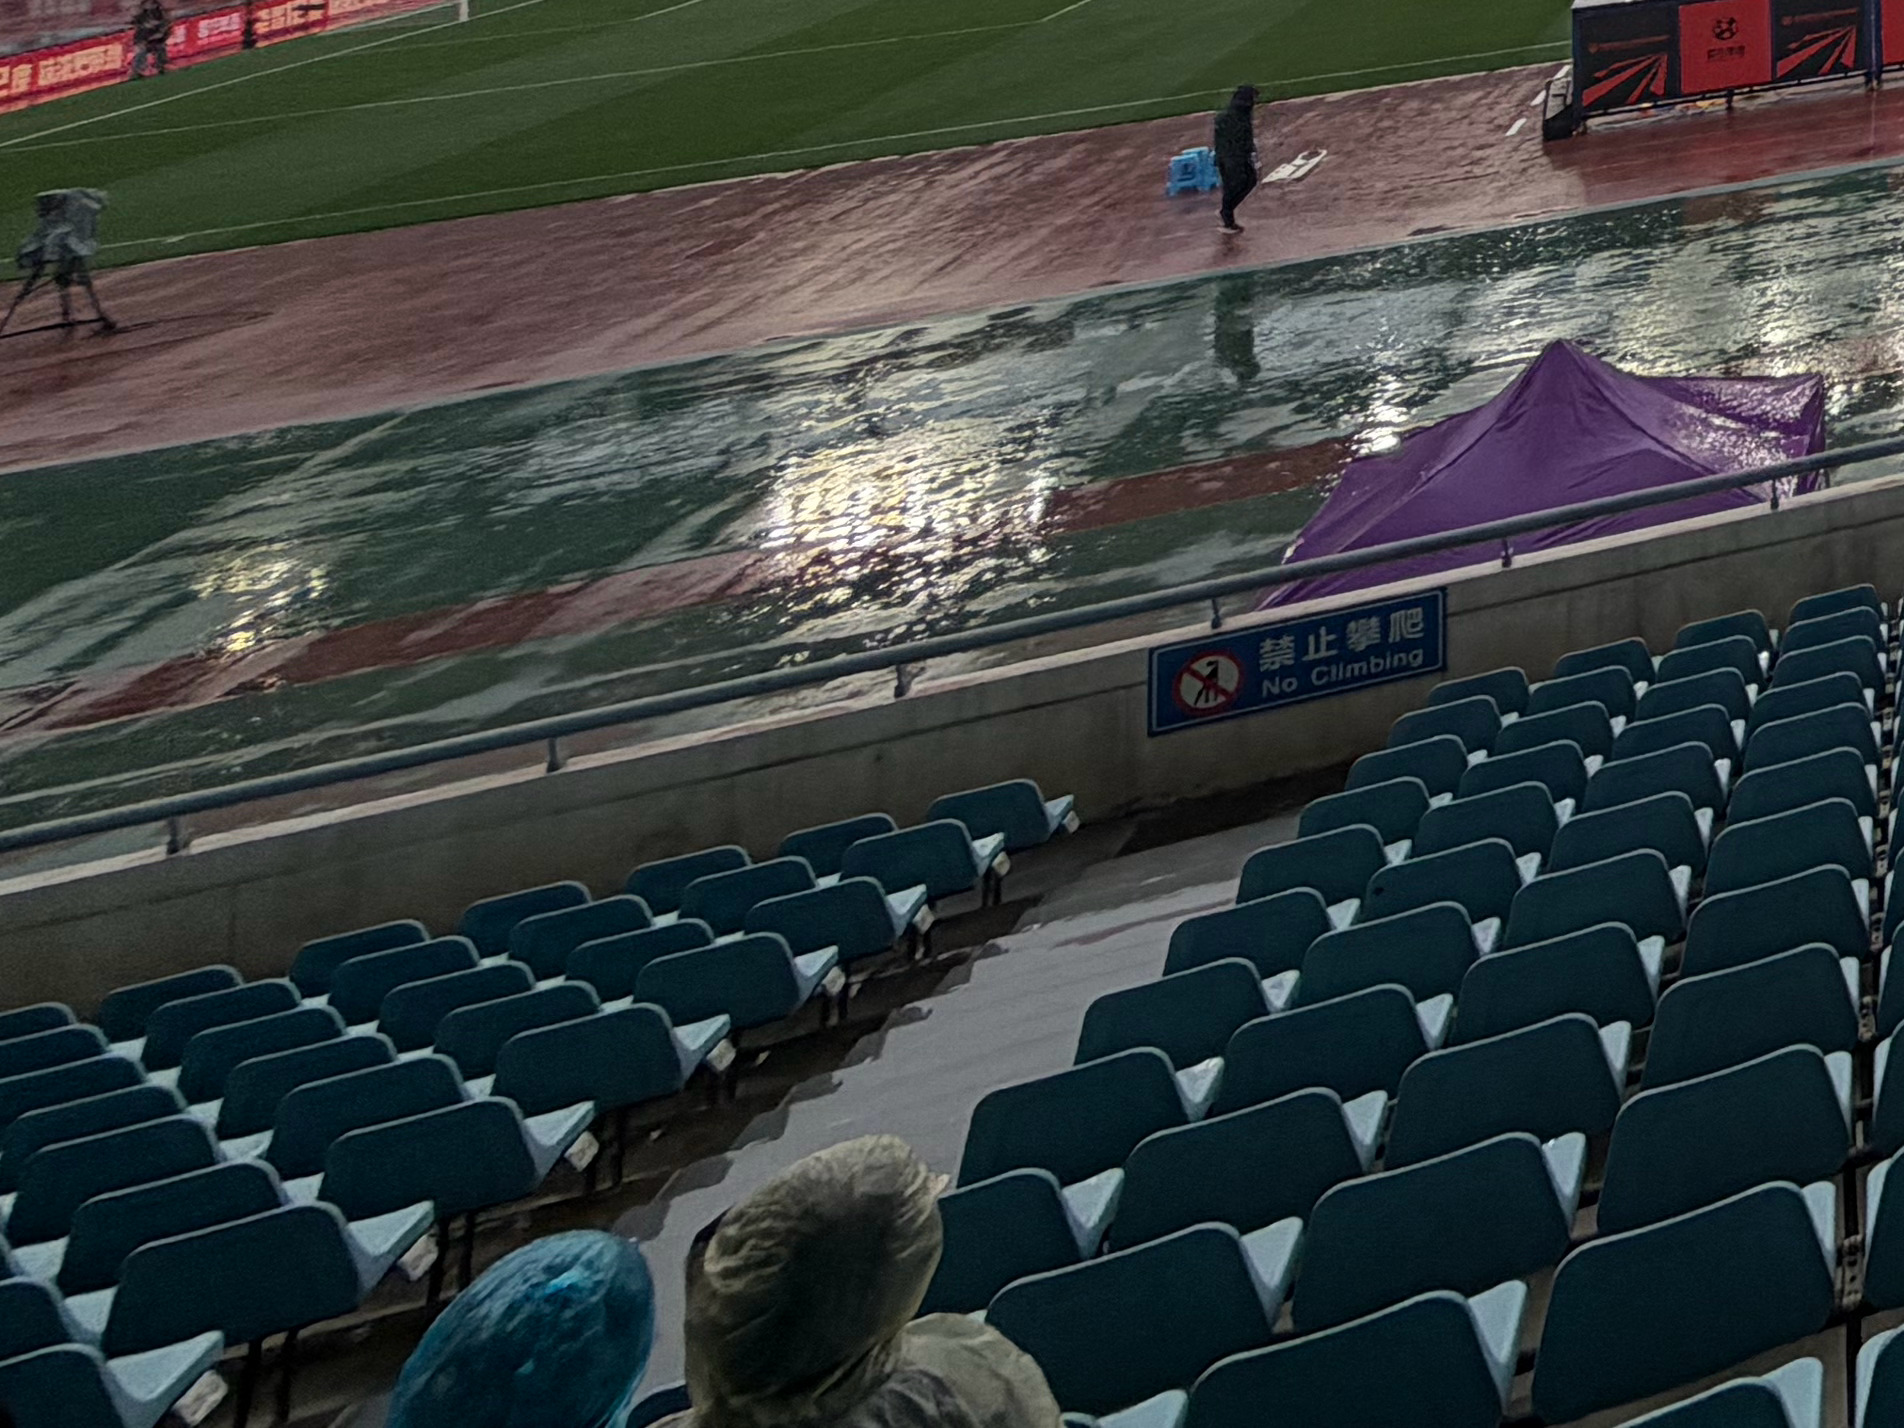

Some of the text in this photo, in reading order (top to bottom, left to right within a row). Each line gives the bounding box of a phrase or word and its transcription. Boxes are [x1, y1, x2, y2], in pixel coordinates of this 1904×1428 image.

[1259, 606, 1424, 672] 禁止攀爬
[1262, 648, 1424, 698] No Climbing
